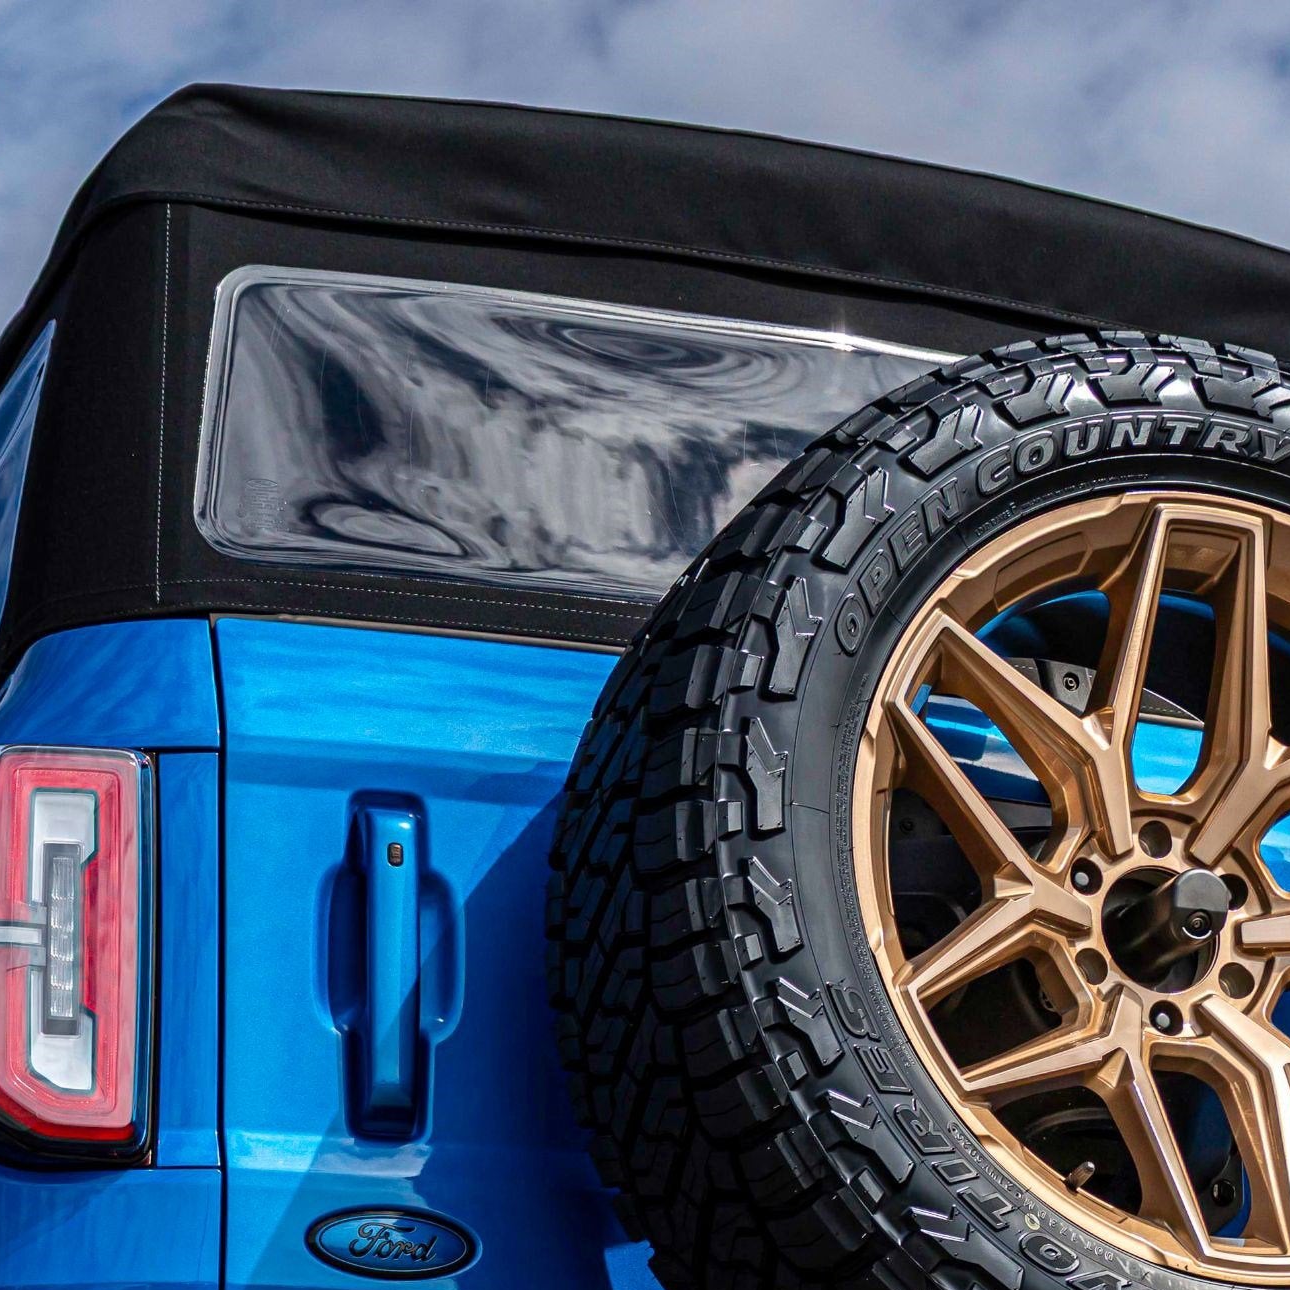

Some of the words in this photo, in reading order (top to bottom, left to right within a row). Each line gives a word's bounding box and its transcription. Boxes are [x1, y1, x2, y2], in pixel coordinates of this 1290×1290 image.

[836, 477, 962, 654] OPEN
[826, 980, 1016, 1232] TIRES
[349, 1222, 437, 1261] Ford
